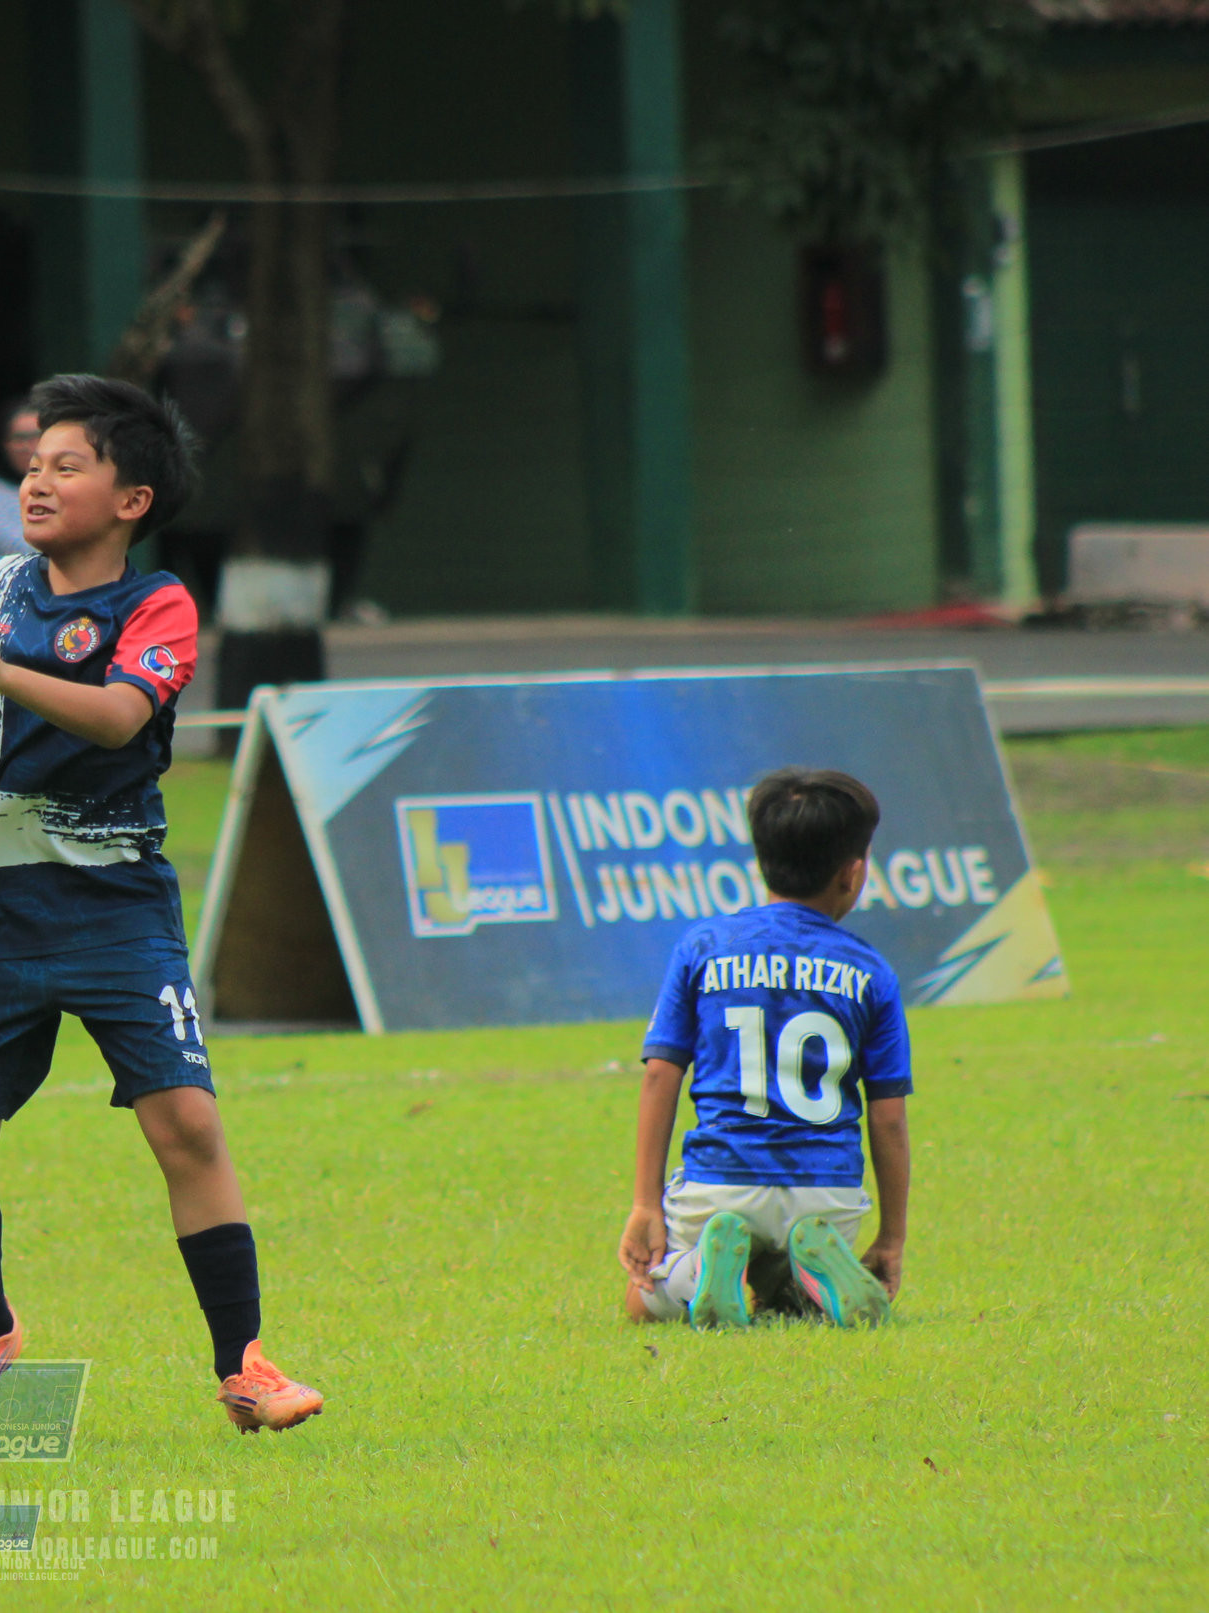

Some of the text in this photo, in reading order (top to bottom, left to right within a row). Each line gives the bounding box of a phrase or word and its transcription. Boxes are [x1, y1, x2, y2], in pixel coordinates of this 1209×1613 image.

[704, 954, 872, 1004] ATHAR RIZKY
[158, 985, 204, 1046] 11
[724, 1005, 852, 1125] 10
